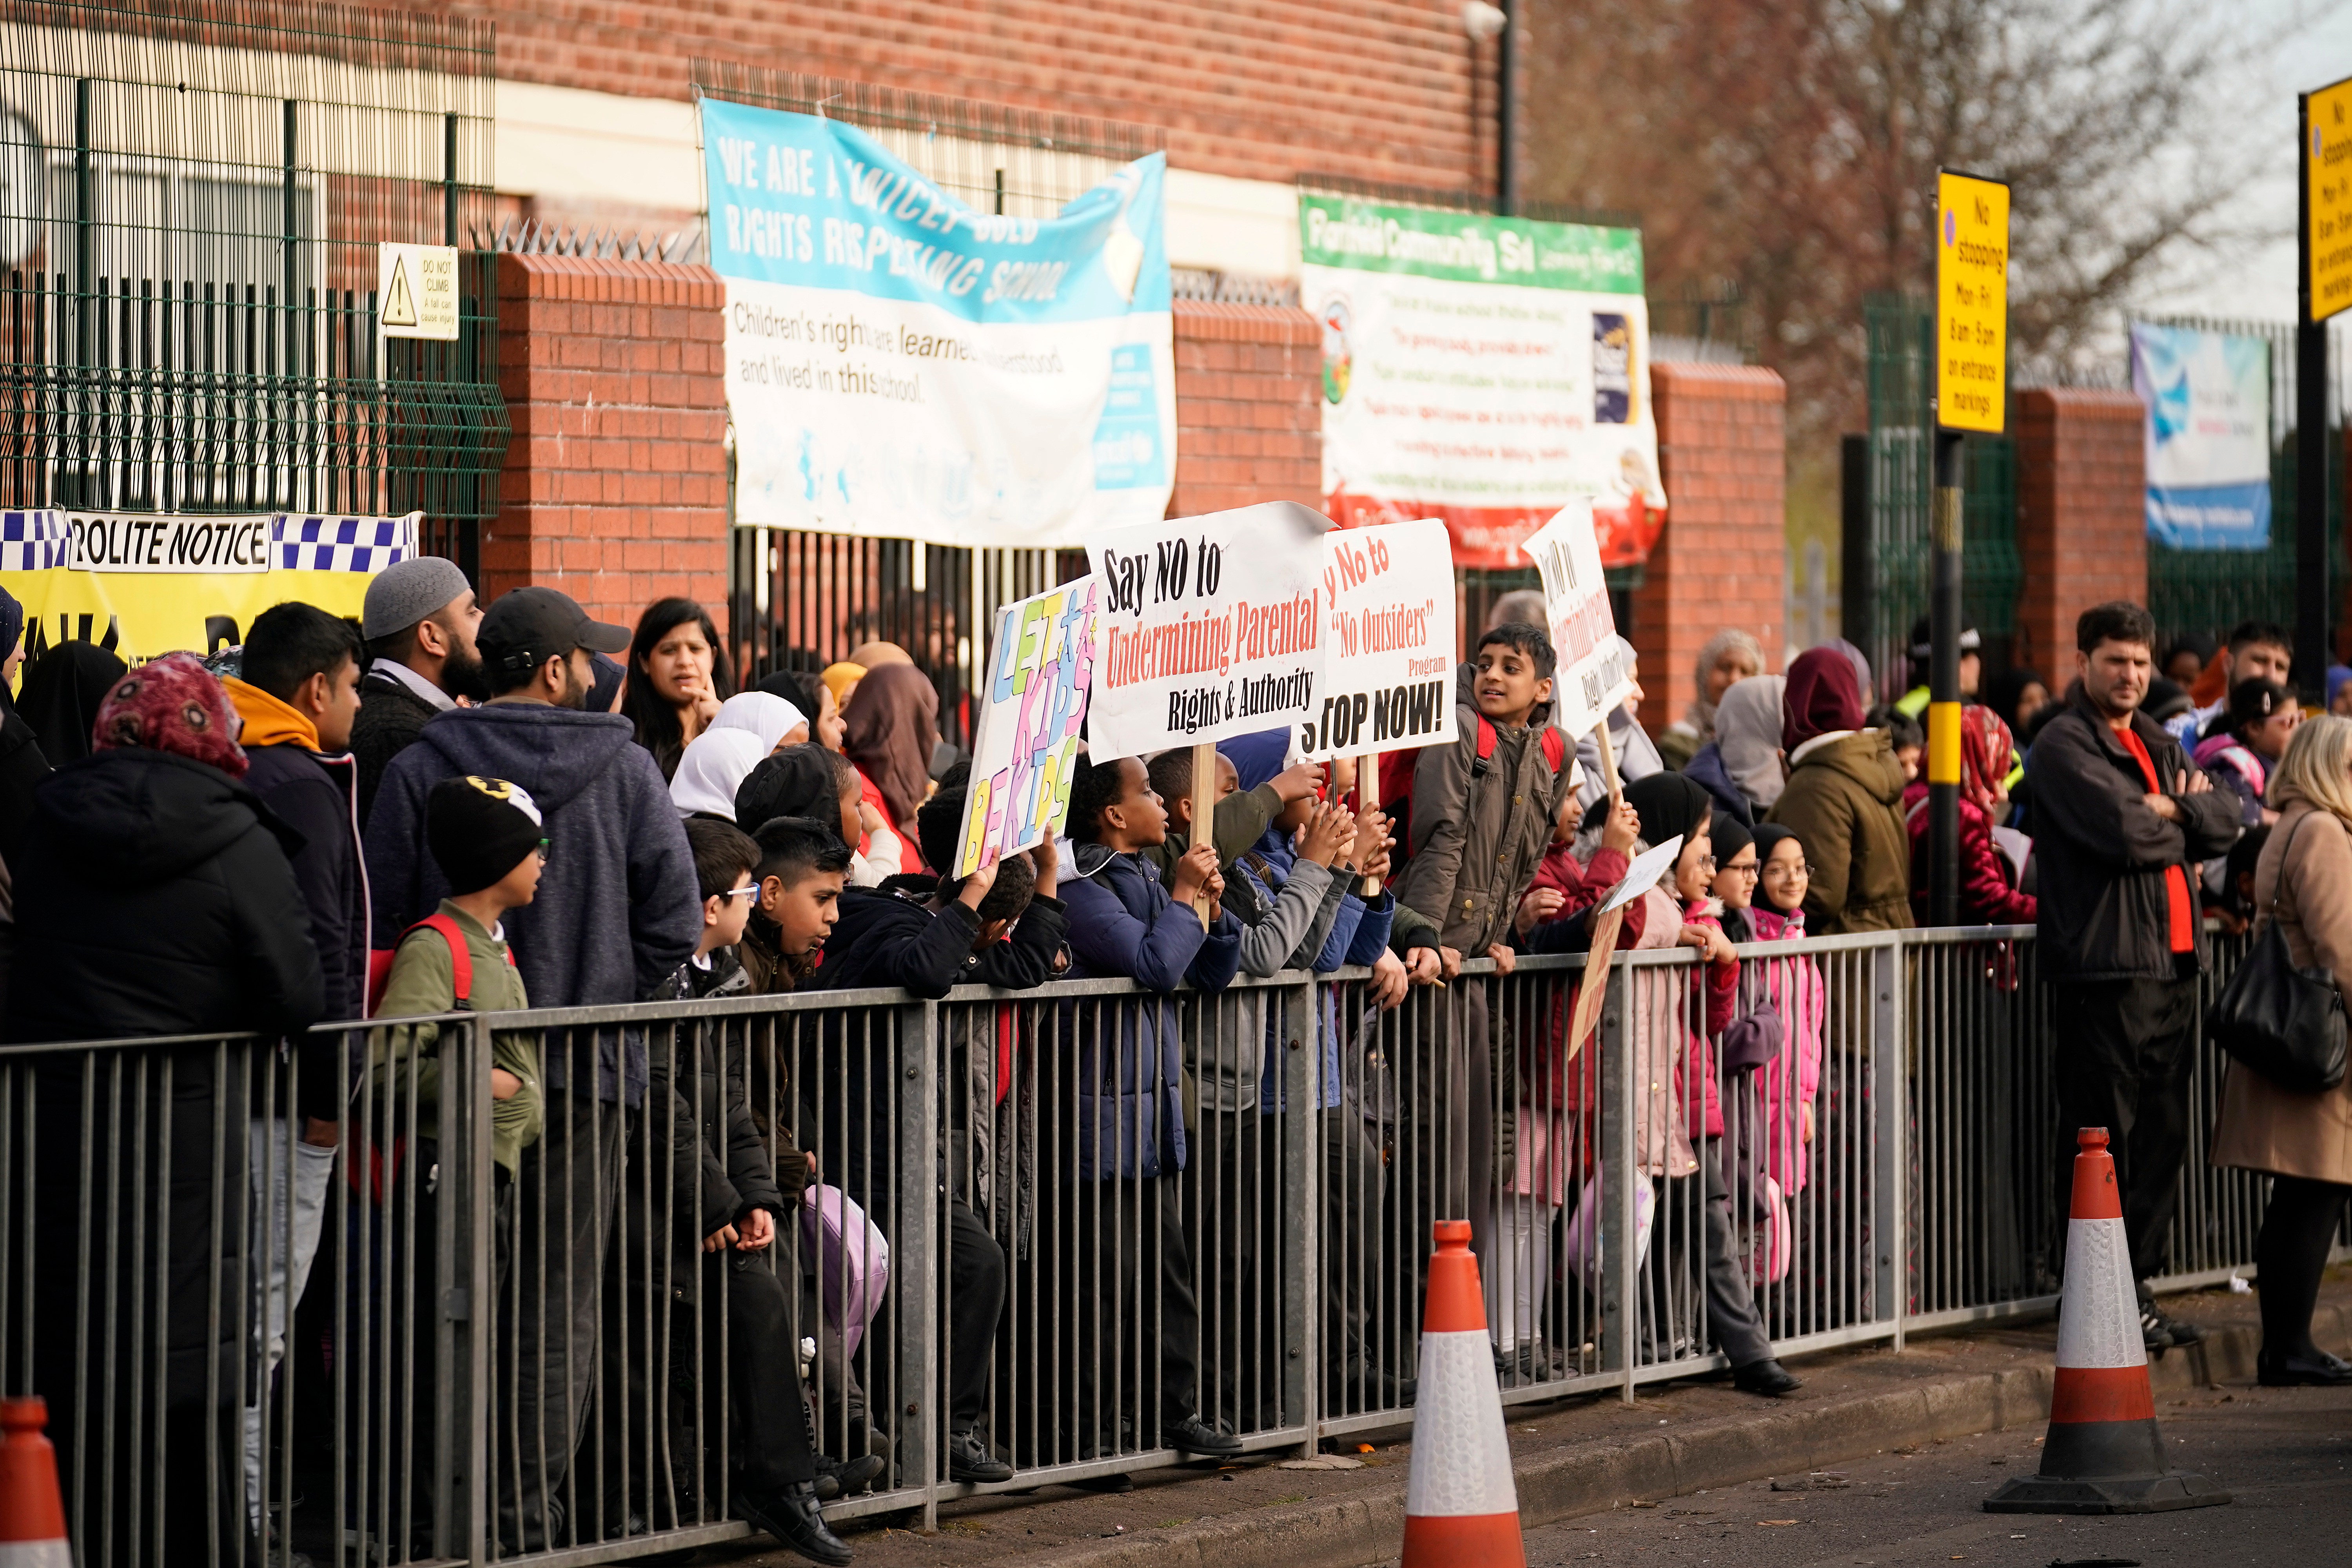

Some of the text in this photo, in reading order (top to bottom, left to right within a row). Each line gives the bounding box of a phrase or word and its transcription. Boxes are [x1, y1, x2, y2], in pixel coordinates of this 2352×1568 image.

[719, 136, 759, 189] WE
[766, 144, 816, 196] ARE
[2324, 133, 2352, 168] stoppin
[1974, 194, 1990, 226] No
[725, 203, 813, 263] RIGHTS
[424, 260, 452, 274] DO NOT
[1959, 235, 2003, 276] stopping
[425, 298, 452, 309] A fall can
[426, 279, 449, 292] CLIMB
[421, 312, 455, 325] cause injury
[734, 301, 815, 342] Children's
[741, 353, 768, 385] and
[773, 354, 811, 389] lived
[817, 361, 833, 391] in
[839, 362, 879, 394] this
[1961, 356, 1997, 383] entrance
[1954, 387, 1991, 418] markings
[72, 518, 266, 566] POLITE NOTICE
[1104, 534, 1221, 617] Say NO to
[1334, 541, 1367, 592] No
[1365, 535, 1389, 576] to
[993, 591, 1064, 703] LET
[1106, 588, 1318, 690] Undermining Parental
[1408, 655, 1446, 677] Program
[1012, 635, 1096, 766] KIDS
[1167, 666, 1314, 735] Rights & Authority
[1374, 680, 1444, 742] NOW!
